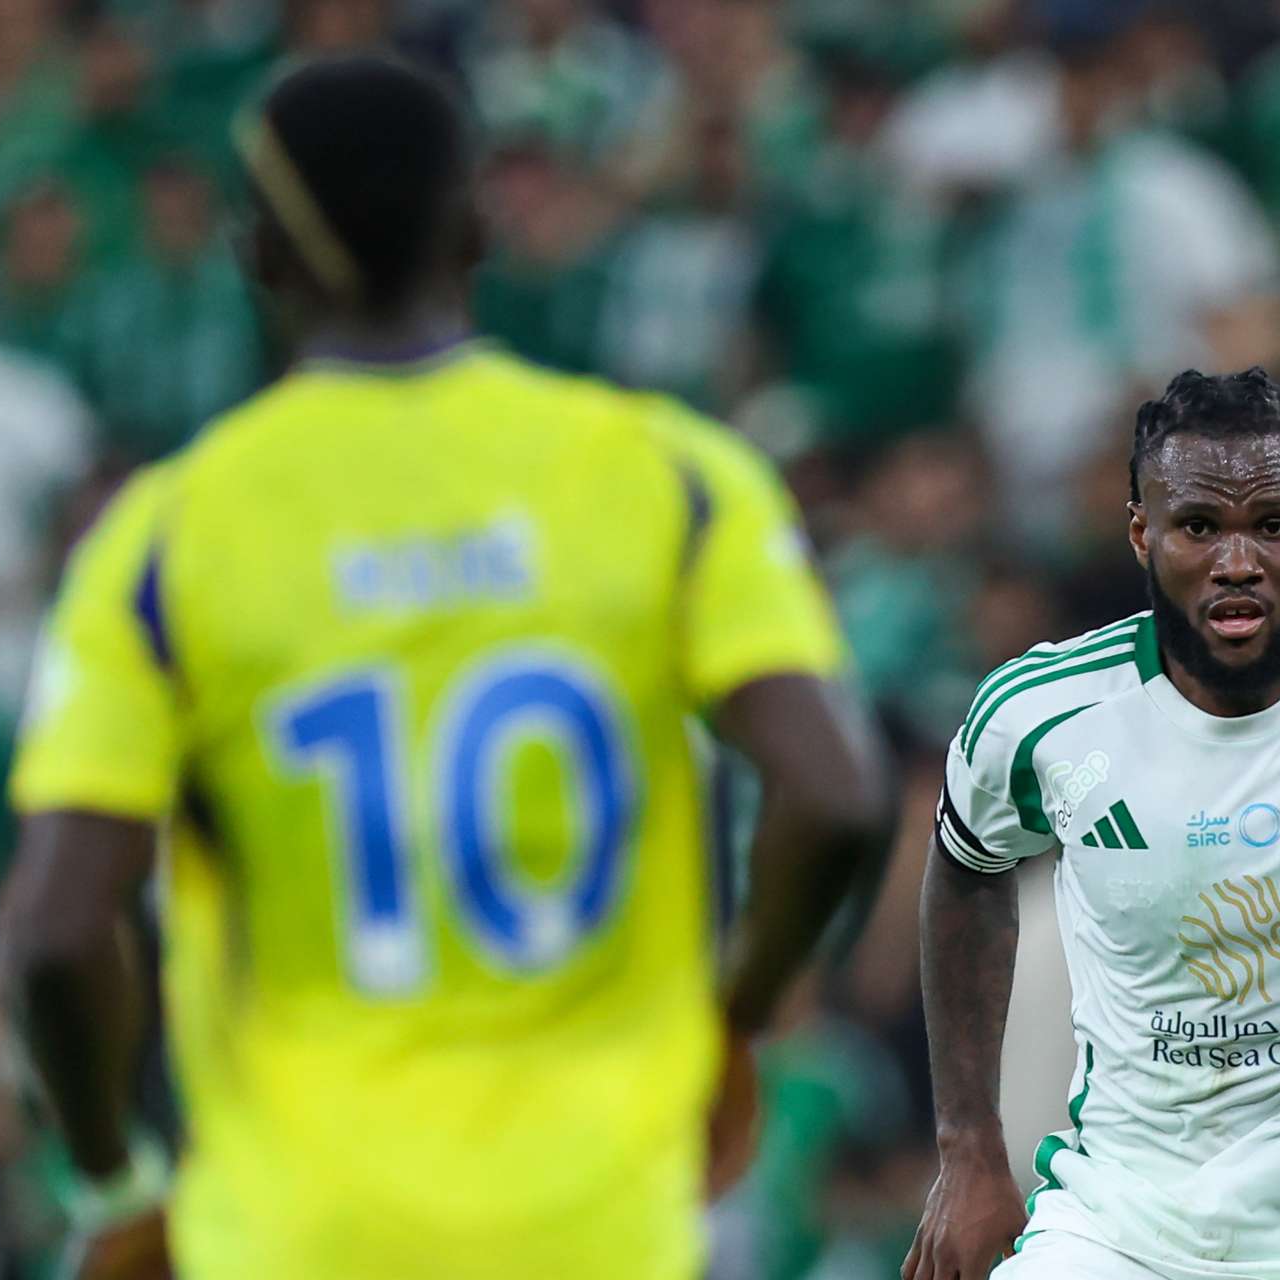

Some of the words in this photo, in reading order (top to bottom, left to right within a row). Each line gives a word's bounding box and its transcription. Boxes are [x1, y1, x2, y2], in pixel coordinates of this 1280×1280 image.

[268, 648, 638, 985] 10
[1186, 832, 1231, 848] SIRC
[1151, 1010, 1228, 1042] الدولية
[1152, 1039, 1203, 1067] Red
[1208, 1046, 1260, 1069] Sea
